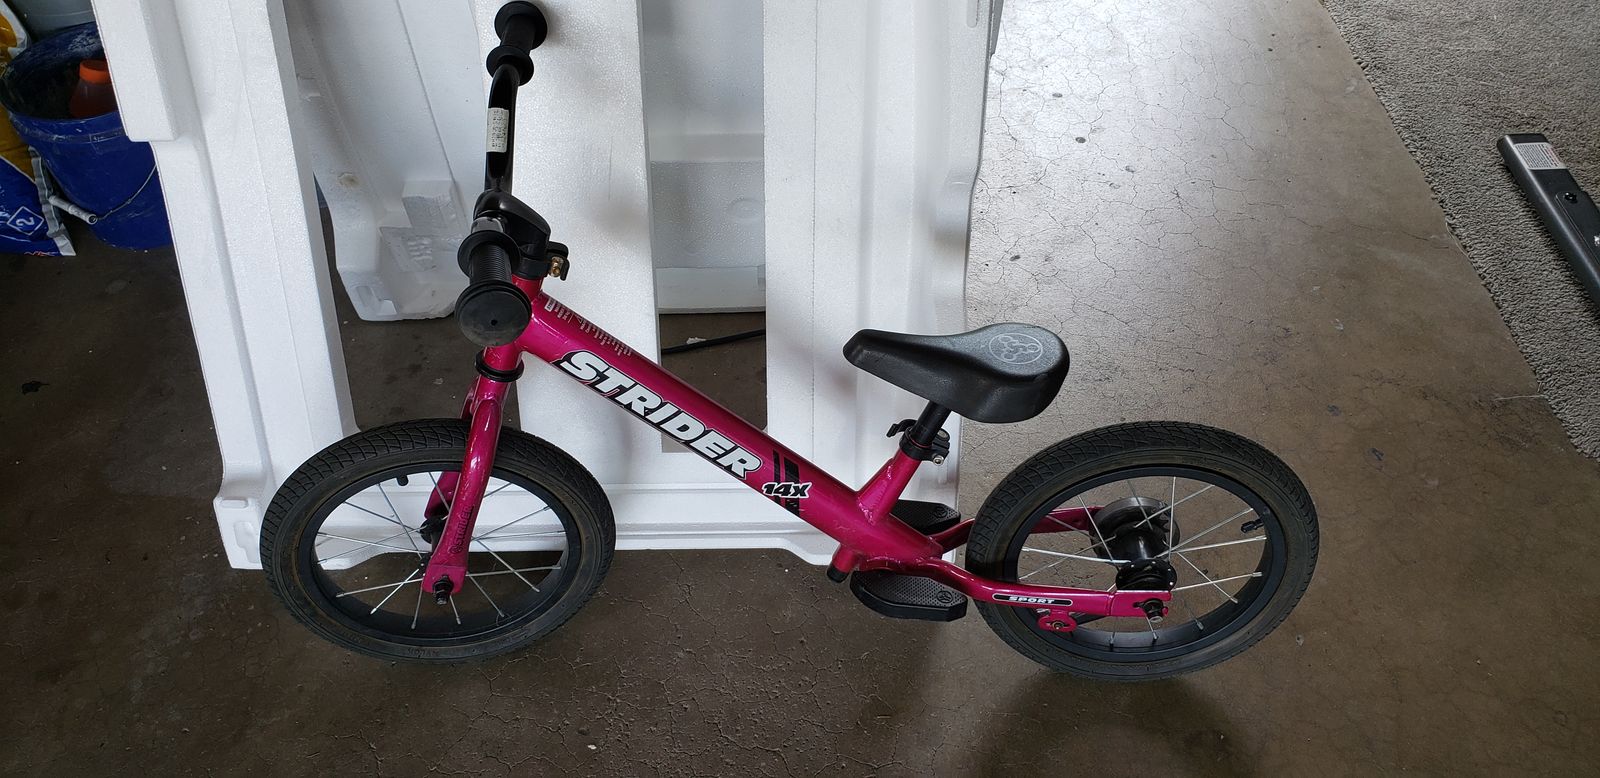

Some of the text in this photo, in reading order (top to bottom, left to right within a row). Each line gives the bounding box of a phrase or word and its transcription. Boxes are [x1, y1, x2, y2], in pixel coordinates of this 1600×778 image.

[557, 350, 763, 480] STRIDER
[455, 505, 475, 545] STRIDER
[1009, 595, 1055, 604] SPORT
